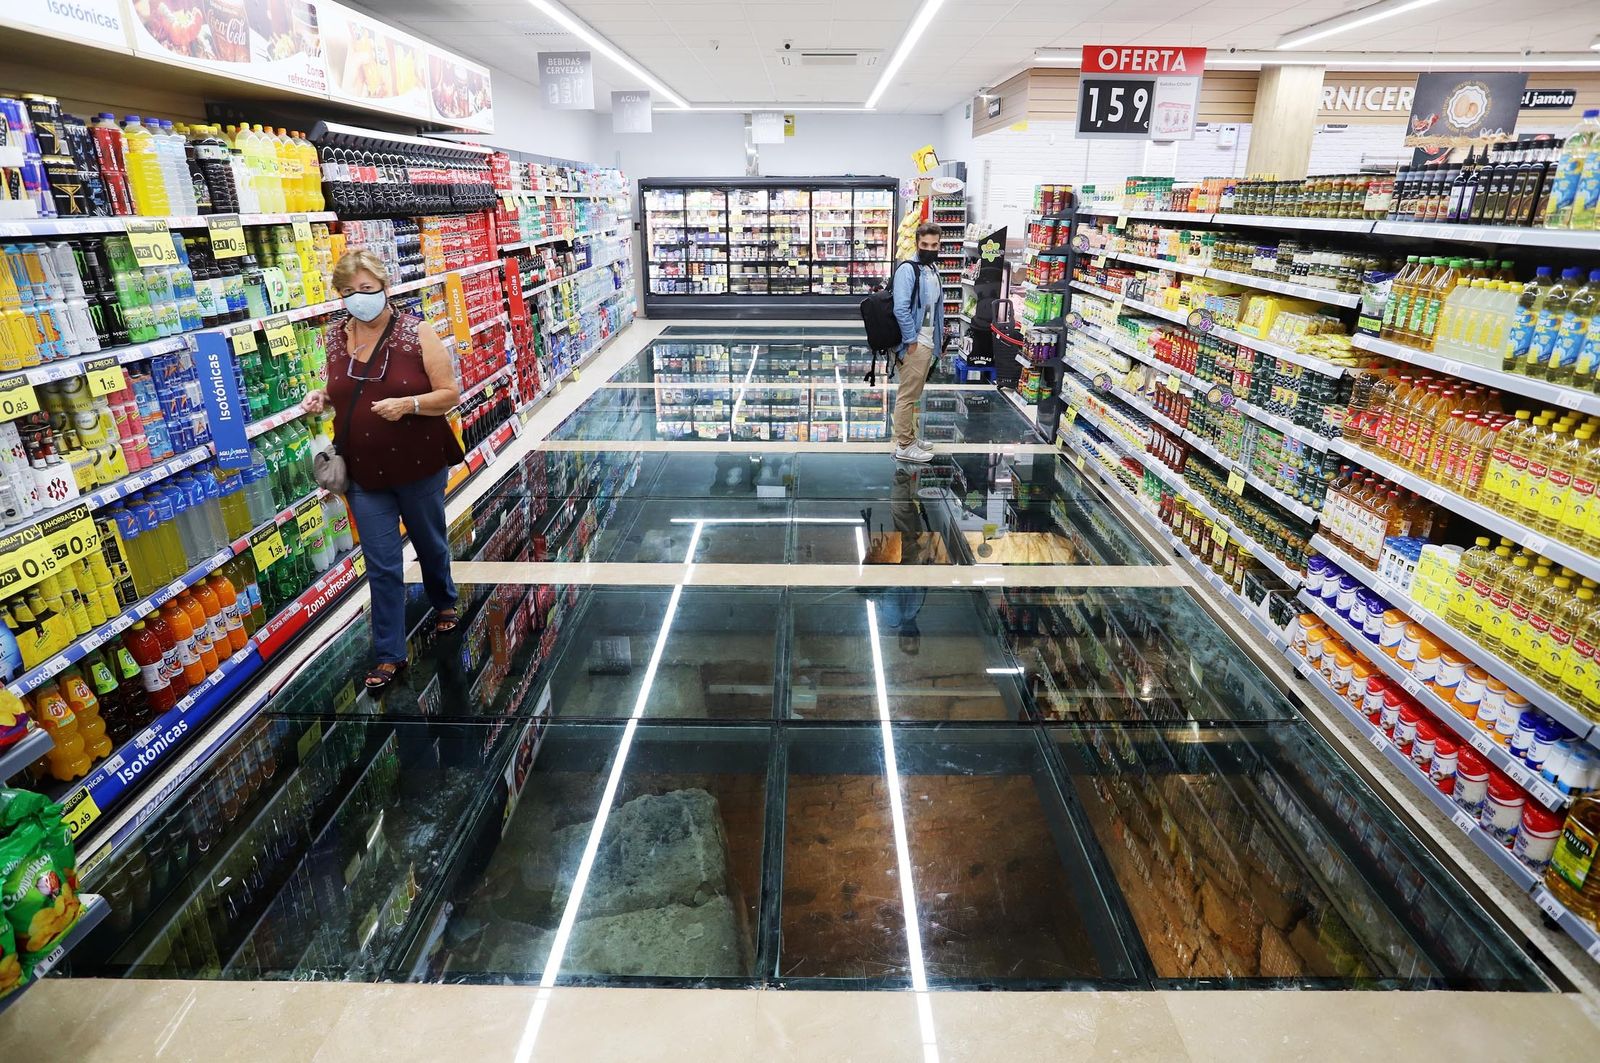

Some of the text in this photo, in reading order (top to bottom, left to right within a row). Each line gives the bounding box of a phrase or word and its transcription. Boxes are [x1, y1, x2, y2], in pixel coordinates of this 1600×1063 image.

[547, 58, 582, 66] BEBIDAS
[1098, 48, 1186, 72] OFERTA
[305, 63, 325, 78] Zona
[546, 66, 584, 75] CERVEZAS
[620, 95, 641, 103] AGUA
[1531, 90, 1574, 108] jamón
[152, 243, 177, 261] 0,36
[511, 275, 519, 296] Colas
[99, 377, 116, 391] 1,15
[208, 353, 231, 421] Isotónicas
[2, 400, 29, 415] 0,83
[70, 505, 88, 522] 50%
[16, 526, 39, 545] 70%
[70, 534, 97, 554] 0,37
[268, 544, 283, 558] 1,38
[22, 557, 56, 579] 0,15
[304, 595, 326, 618] Zona
[116, 719, 188, 785] Isotónicas
[69, 812, 92, 834] 0,49
